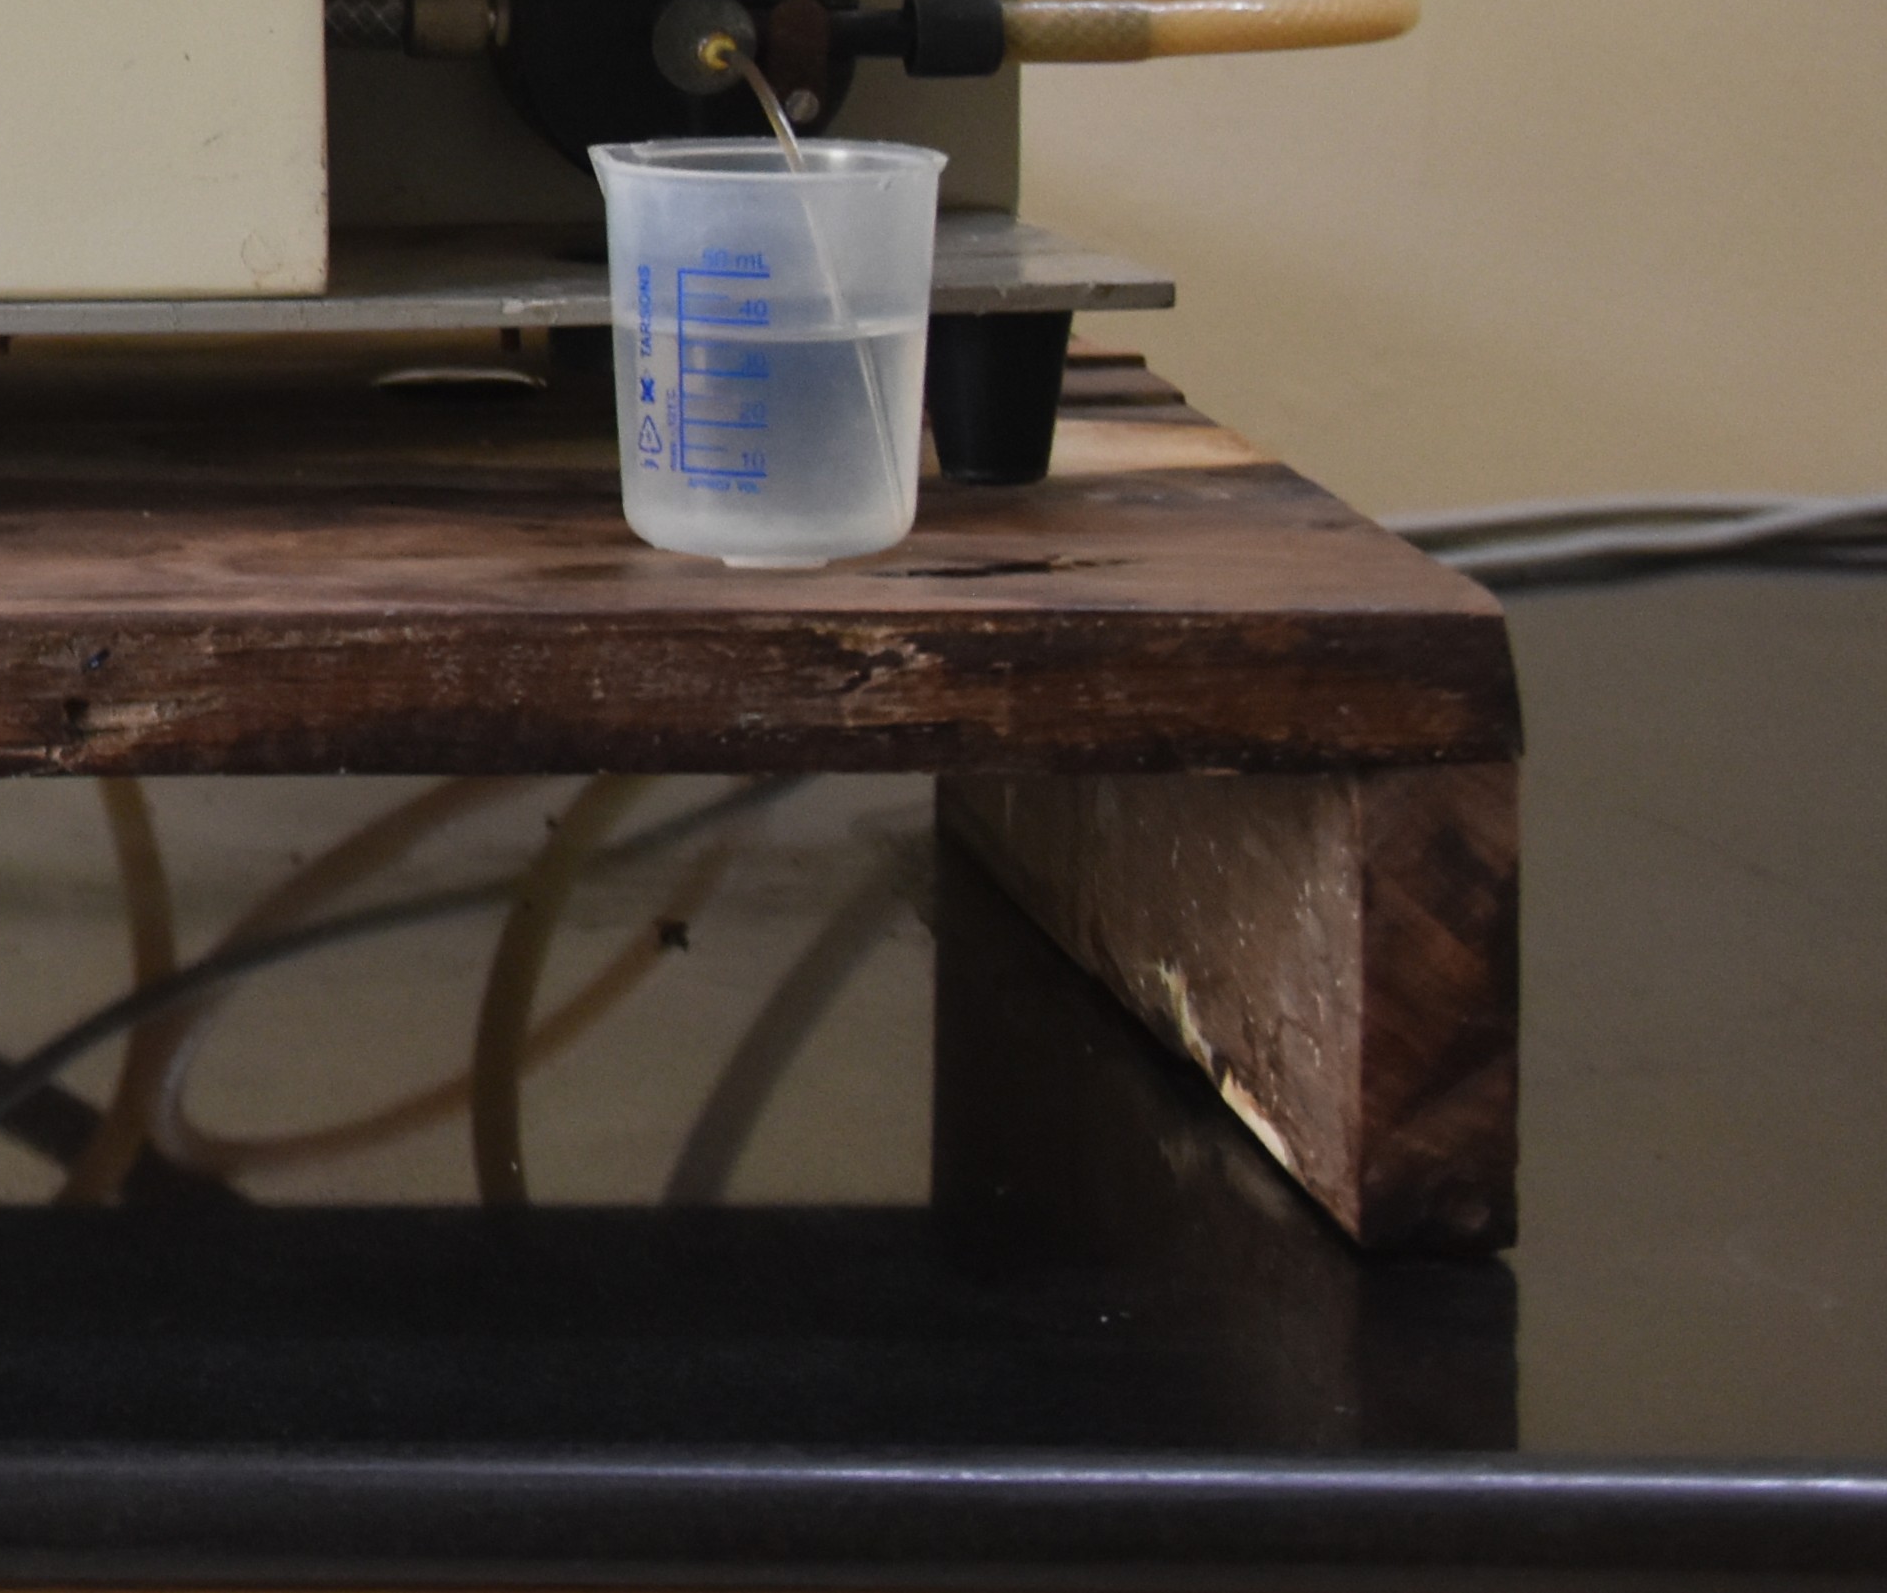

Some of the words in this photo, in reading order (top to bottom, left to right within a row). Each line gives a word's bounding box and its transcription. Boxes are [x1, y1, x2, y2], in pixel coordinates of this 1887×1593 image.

[637, 264, 653, 357] TARSONS
[739, 299, 768, 318] 40
[740, 451, 766, 470] 10
